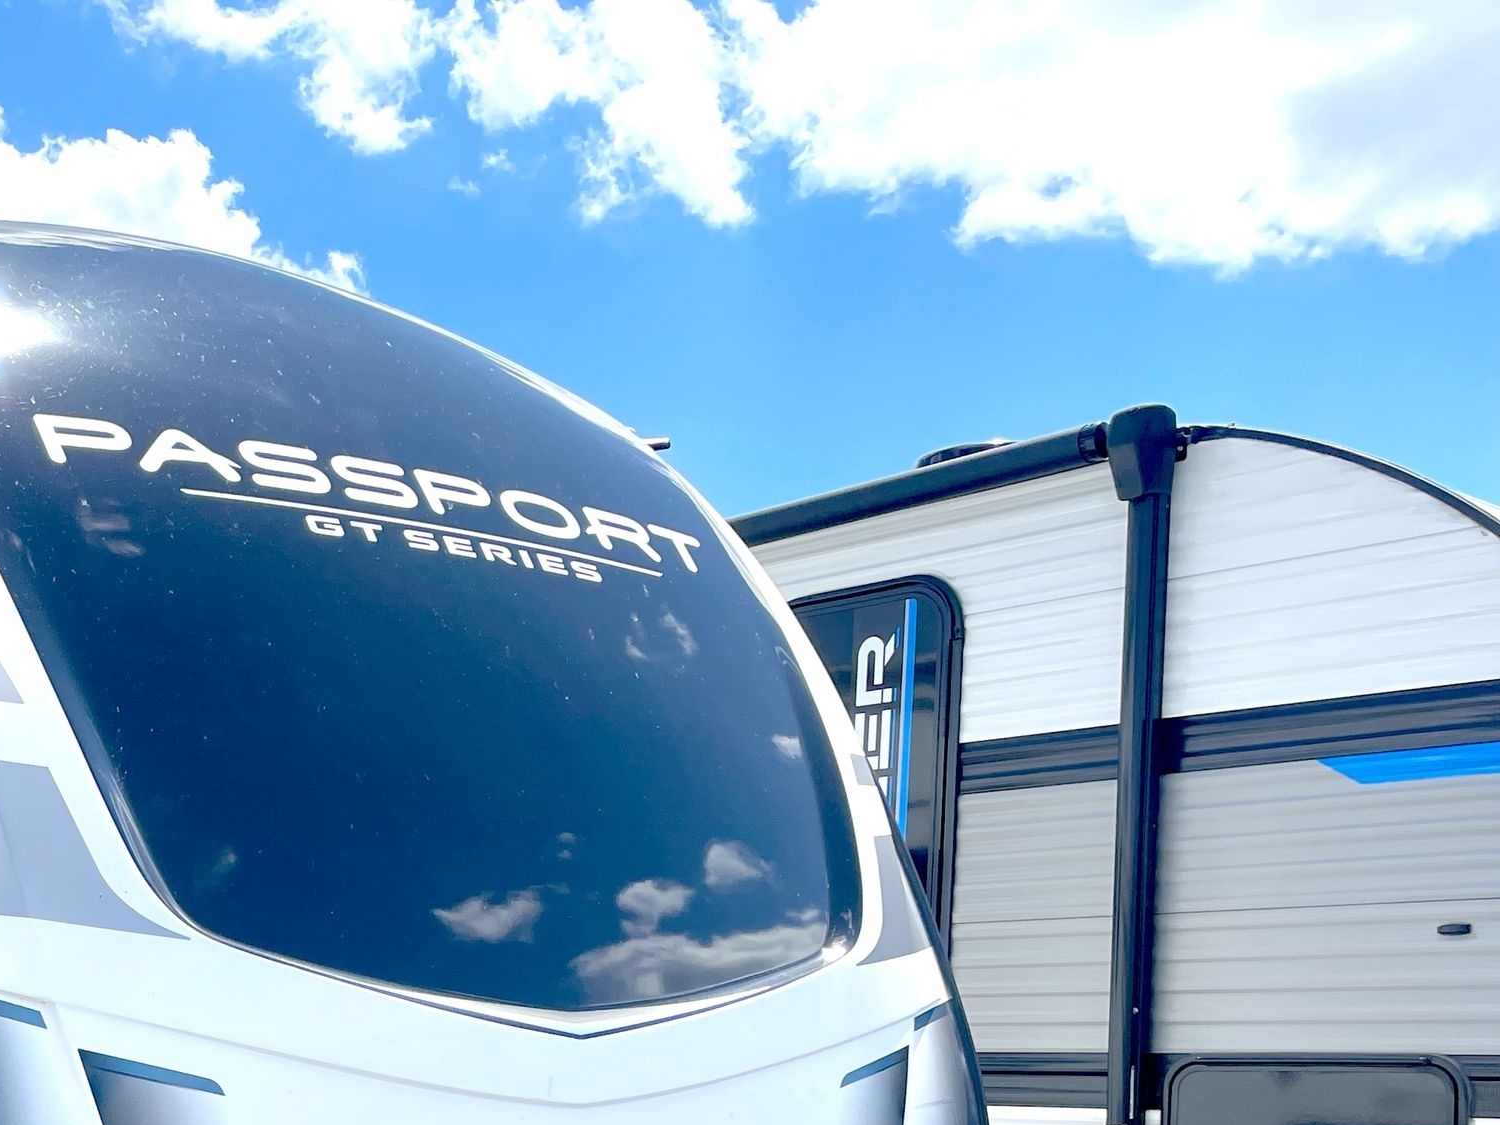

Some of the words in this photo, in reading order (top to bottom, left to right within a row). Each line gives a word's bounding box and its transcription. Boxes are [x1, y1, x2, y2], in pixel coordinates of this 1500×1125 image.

[32, 413, 700, 573] PASSPORT
[305, 514, 382, 543] GT
[402, 529, 603, 583] SERIES
